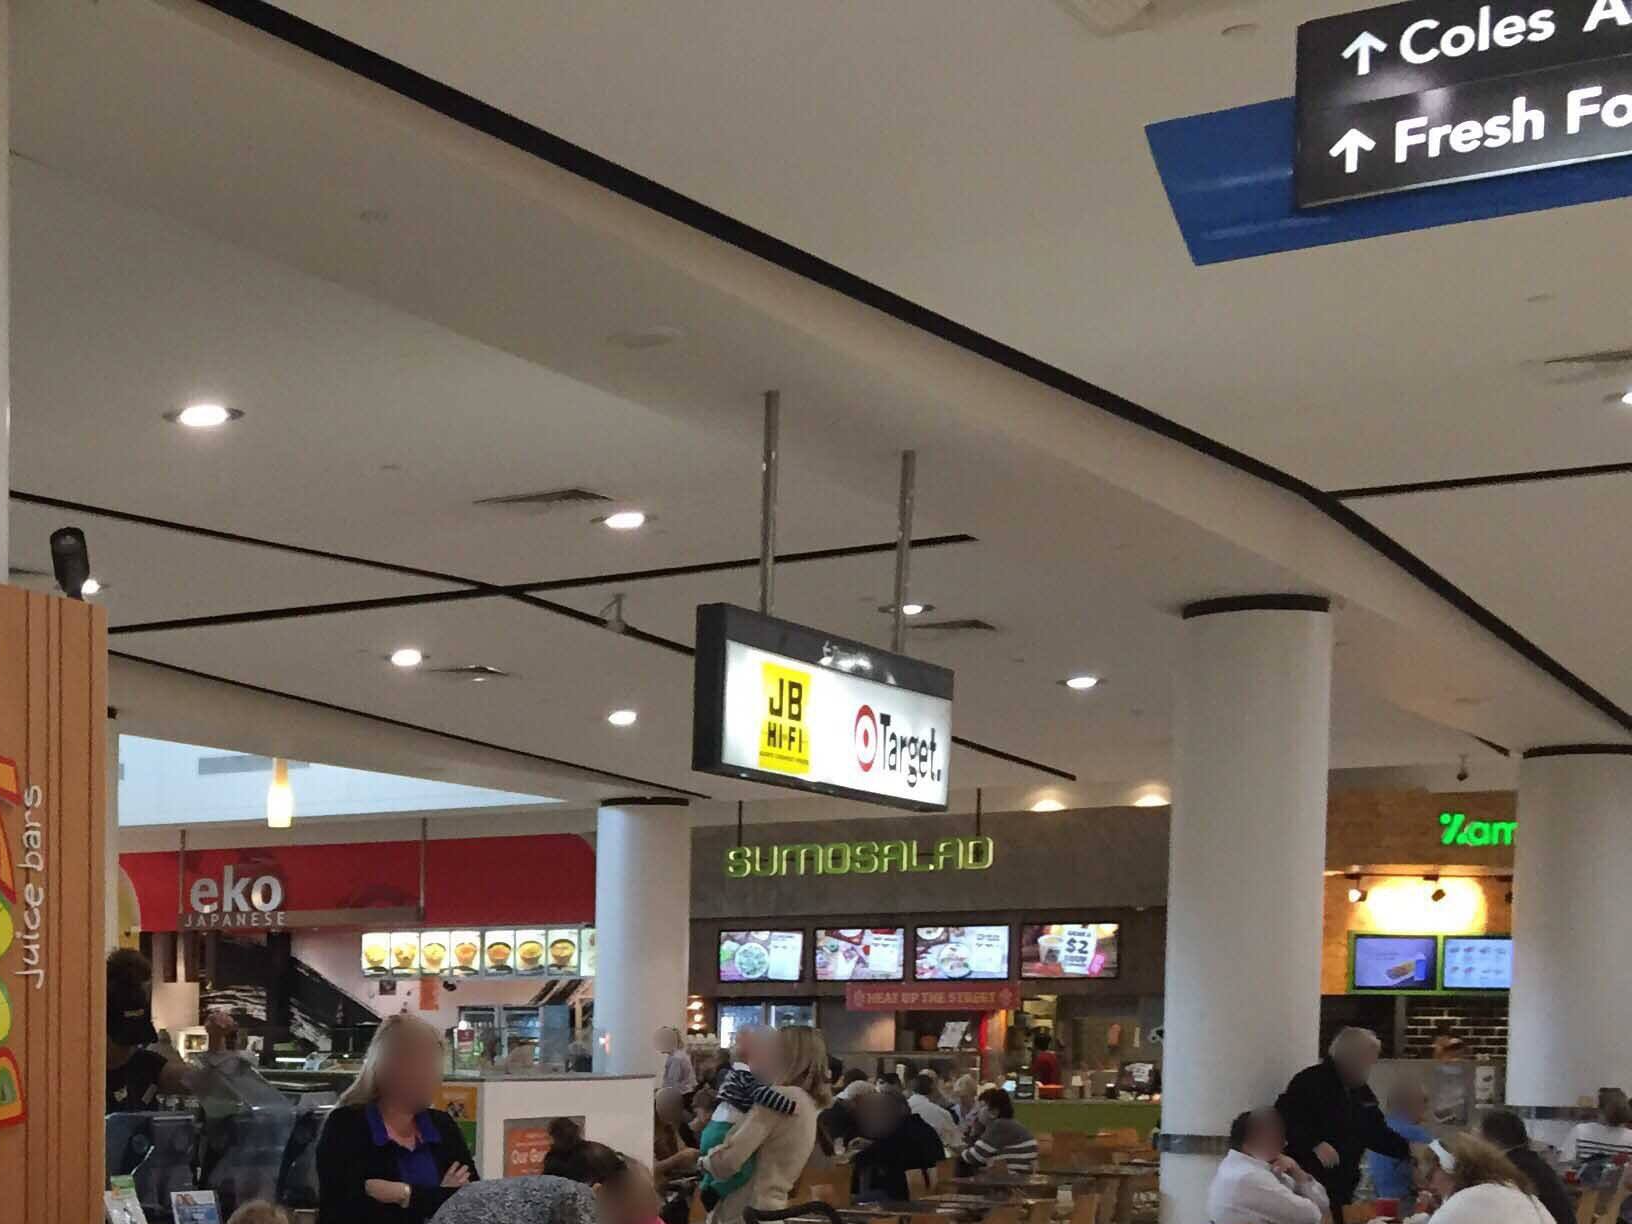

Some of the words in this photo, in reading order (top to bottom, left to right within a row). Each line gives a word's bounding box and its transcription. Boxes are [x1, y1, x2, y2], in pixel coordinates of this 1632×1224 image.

[1398, 5, 1556, 65] Coles
[1394, 95, 1545, 164] Fresh
[769, 677, 803, 722] JB
[16, 784, 44, 871] bars
[190, 864, 282, 914] eko
[184, 911, 286, 928] JAPANESE
[1066, 937, 1089, 954] $2
